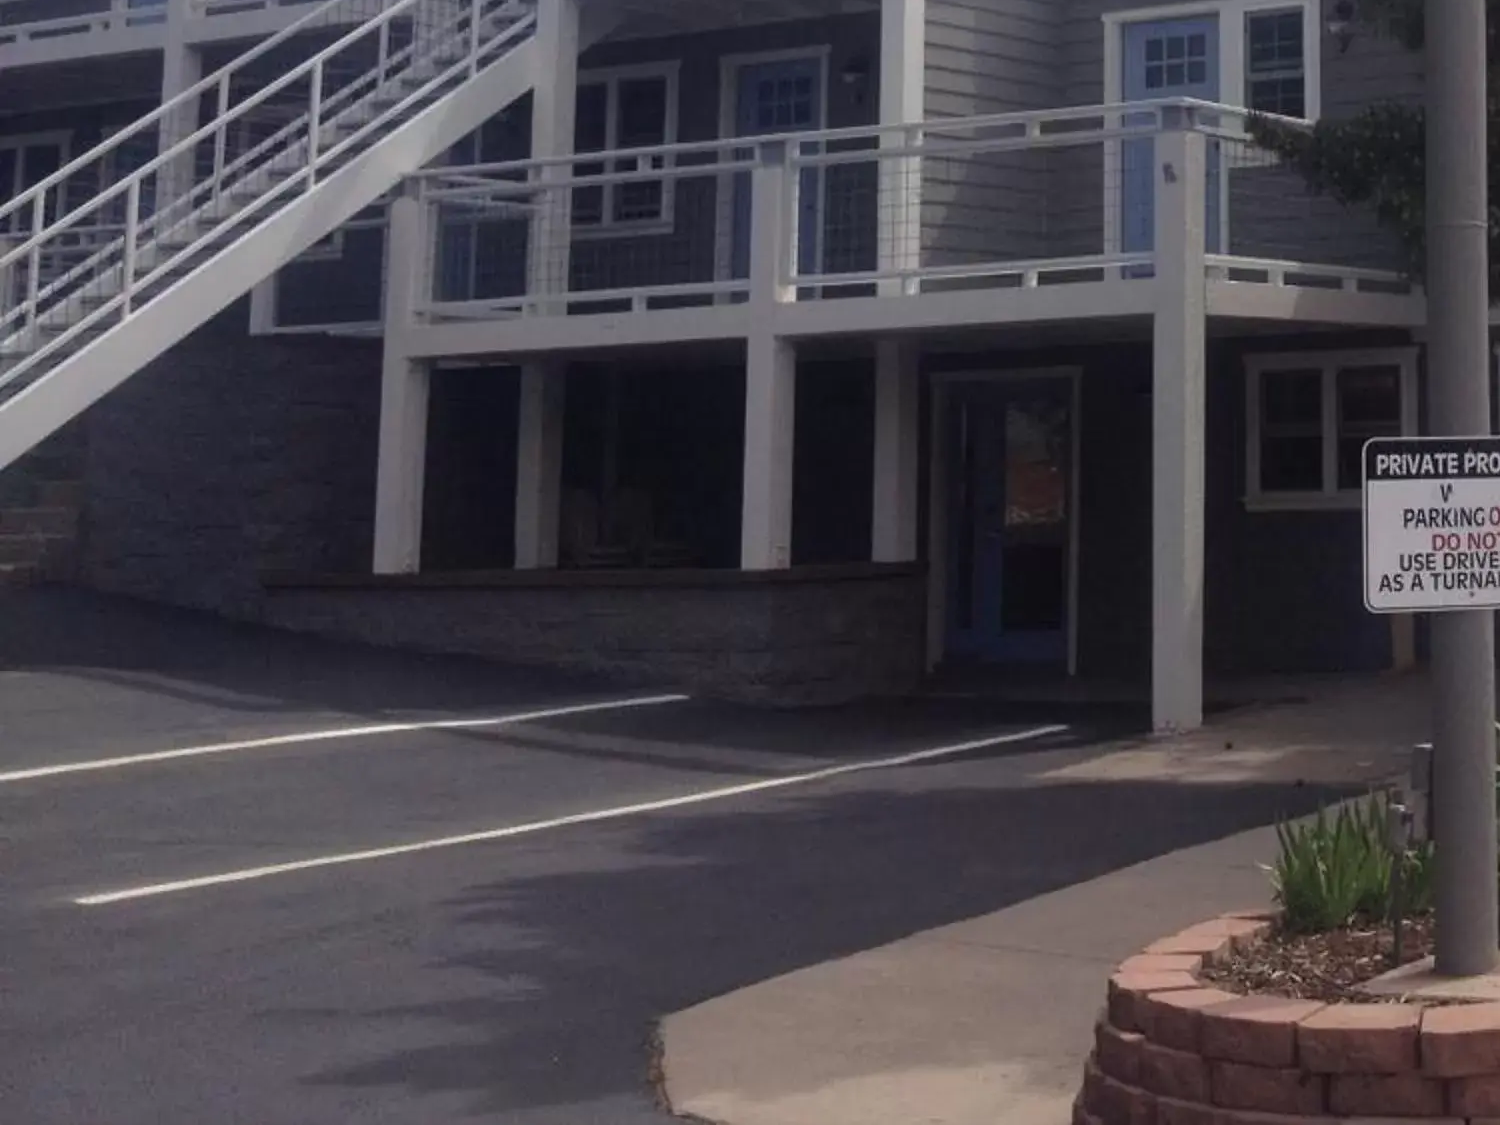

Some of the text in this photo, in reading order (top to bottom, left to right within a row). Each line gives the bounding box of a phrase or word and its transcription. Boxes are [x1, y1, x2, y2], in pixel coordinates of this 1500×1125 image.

[1376, 452, 1458, 476] PRIVATE
[1403, 506, 1485, 530] PARKING
[1431, 532, 1461, 552] DO
[1400, 552, 1437, 572] USE
[1378, 573, 1405, 593] AS
[1410, 572, 1425, 592] A
